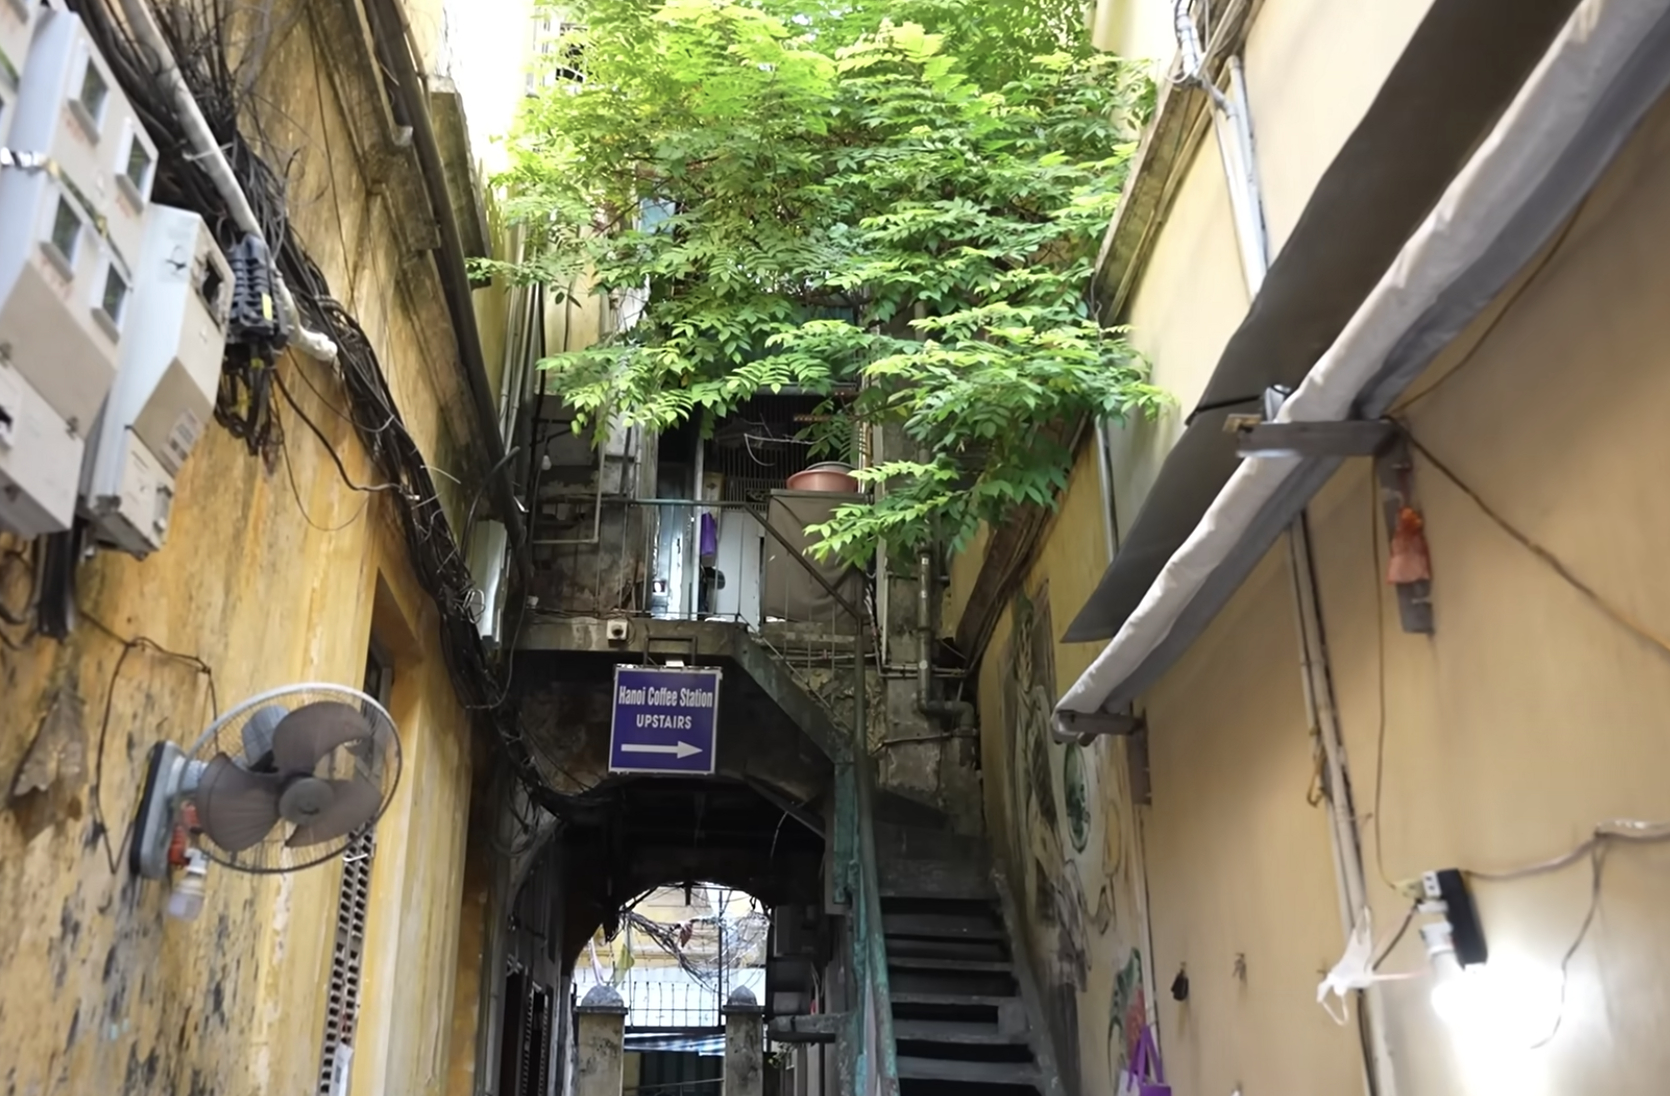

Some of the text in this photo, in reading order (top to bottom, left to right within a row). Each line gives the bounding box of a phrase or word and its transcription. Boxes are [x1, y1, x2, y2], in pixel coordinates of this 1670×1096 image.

[618, 686, 713, 707] Hanoi Coffee Station
[636, 714, 692, 729] UPSTAIRS
